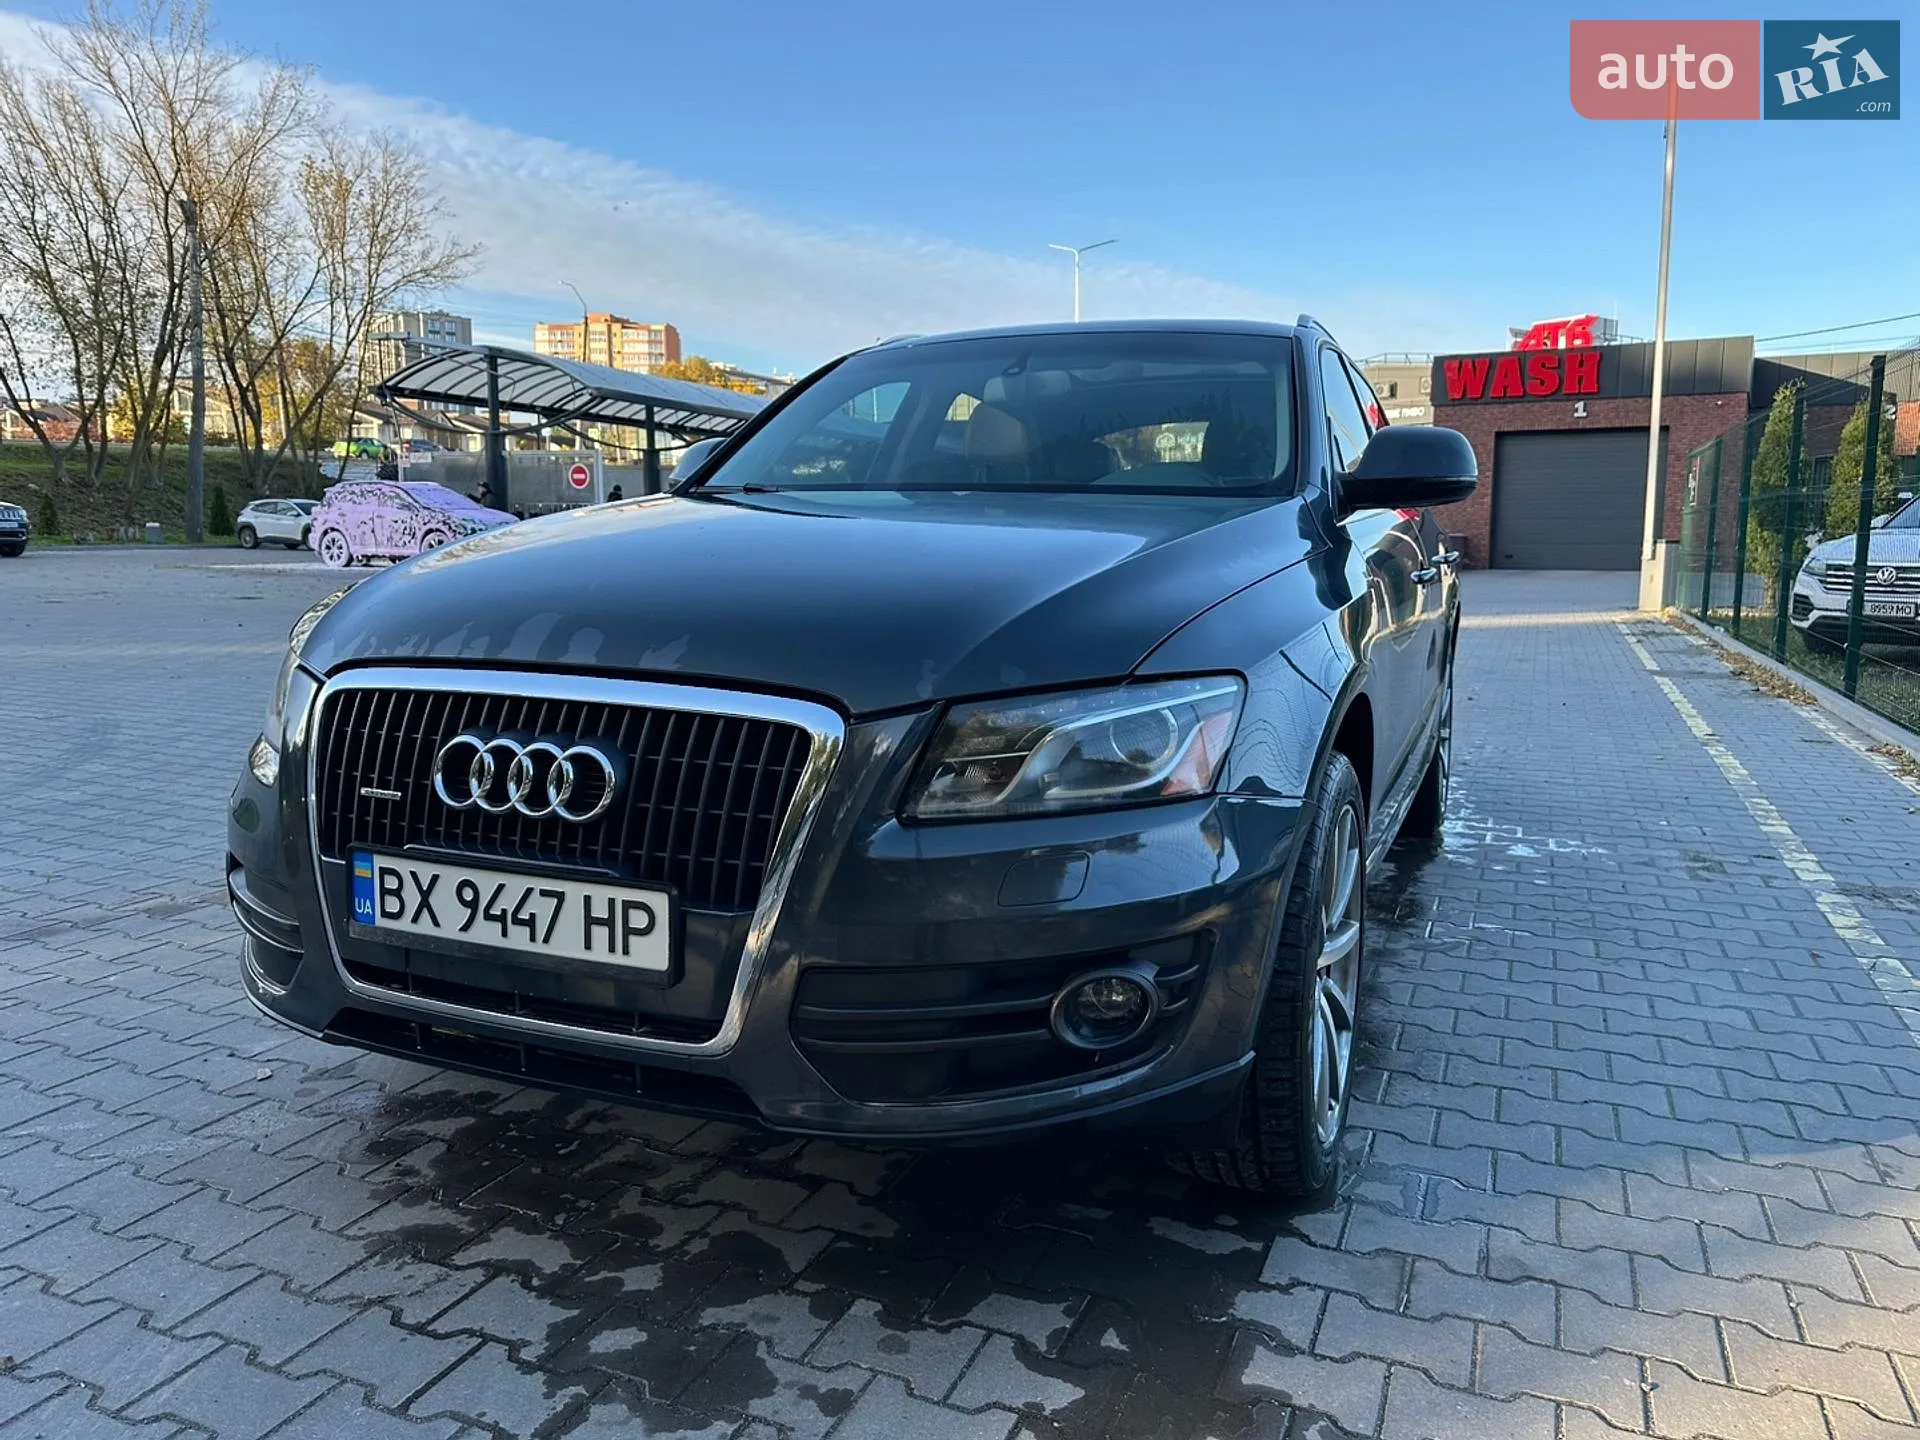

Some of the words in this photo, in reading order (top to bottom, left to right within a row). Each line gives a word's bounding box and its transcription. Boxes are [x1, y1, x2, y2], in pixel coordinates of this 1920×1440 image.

[1443, 352, 1602, 400] WASH
[1573, 400, 1588, 418] 1
[355, 897, 373, 916] UA
[378, 865, 442, 929] BX
[455, 878, 566, 945] 9447
[582, 893, 656, 956] HP
